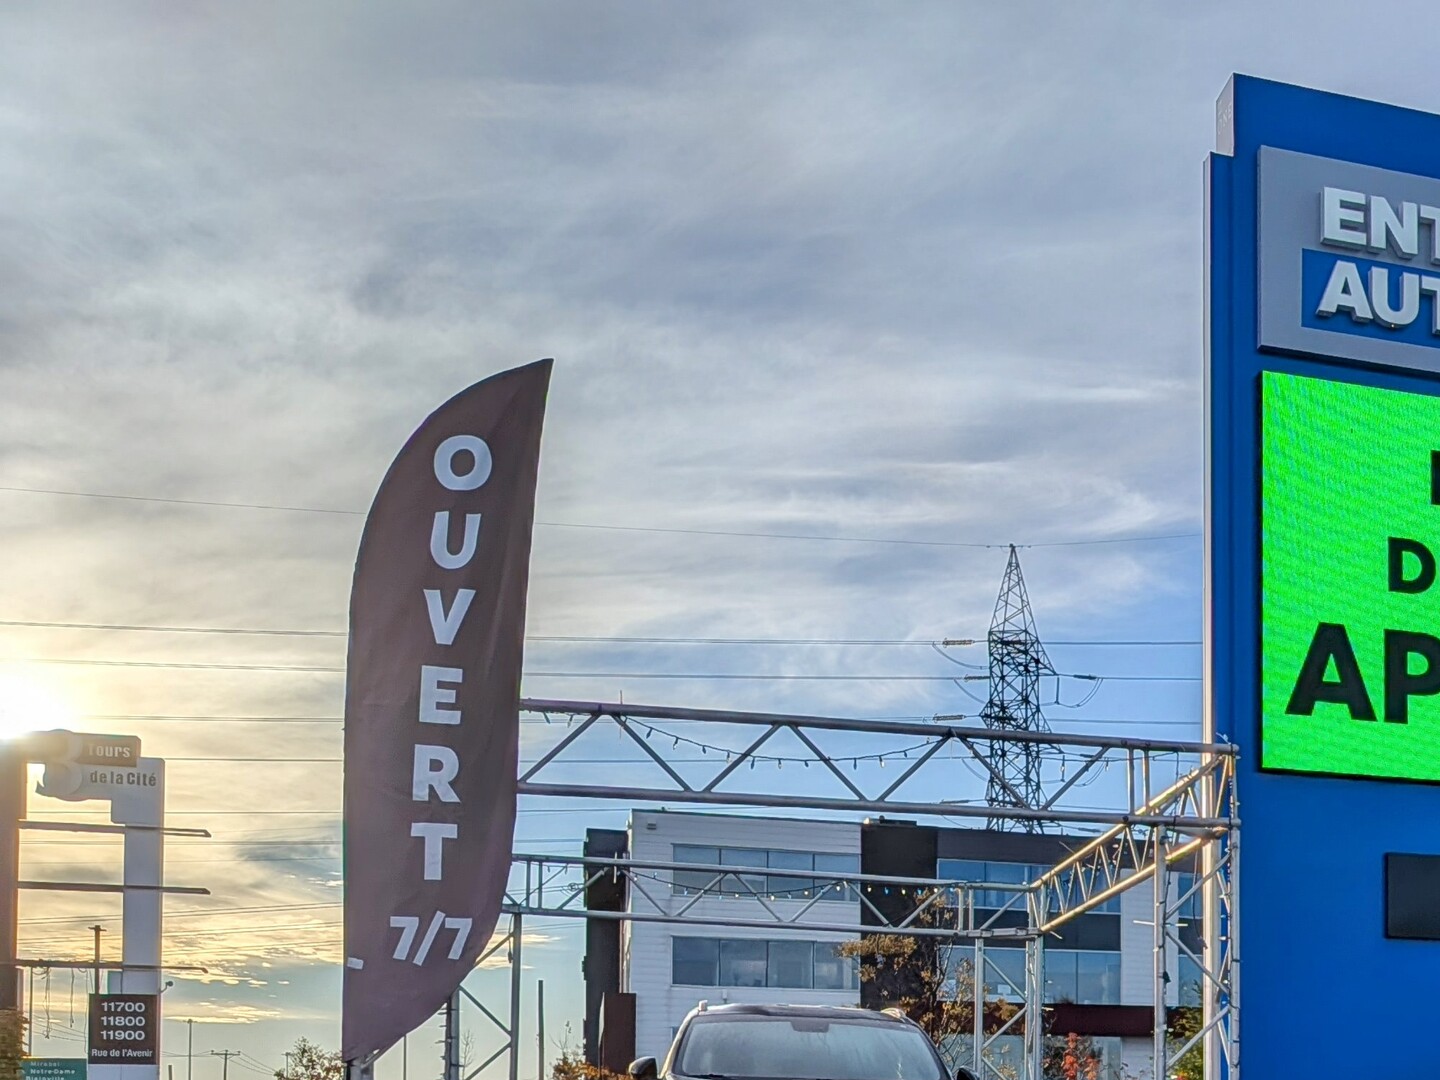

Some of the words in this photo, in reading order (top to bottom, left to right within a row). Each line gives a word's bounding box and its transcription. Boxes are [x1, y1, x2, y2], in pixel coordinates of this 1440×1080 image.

[410, 434, 493, 881] OUVERT
[88, 744, 131, 758] Tours
[90, 770, 106, 784] de
[110, 771, 123, 785] la
[127, 772, 157, 787] Cité
[389, 910, 473, 967] 7/7
[101, 1002, 145, 1013] 11700
[100, 1016, 145, 1027] 11800
[100, 1030, 145, 1041] 11900
[91, 1048, 108, 1057] Rue
[110, 1048, 120, 1057] de
[122, 1048, 153, 1058] l'Avenir
